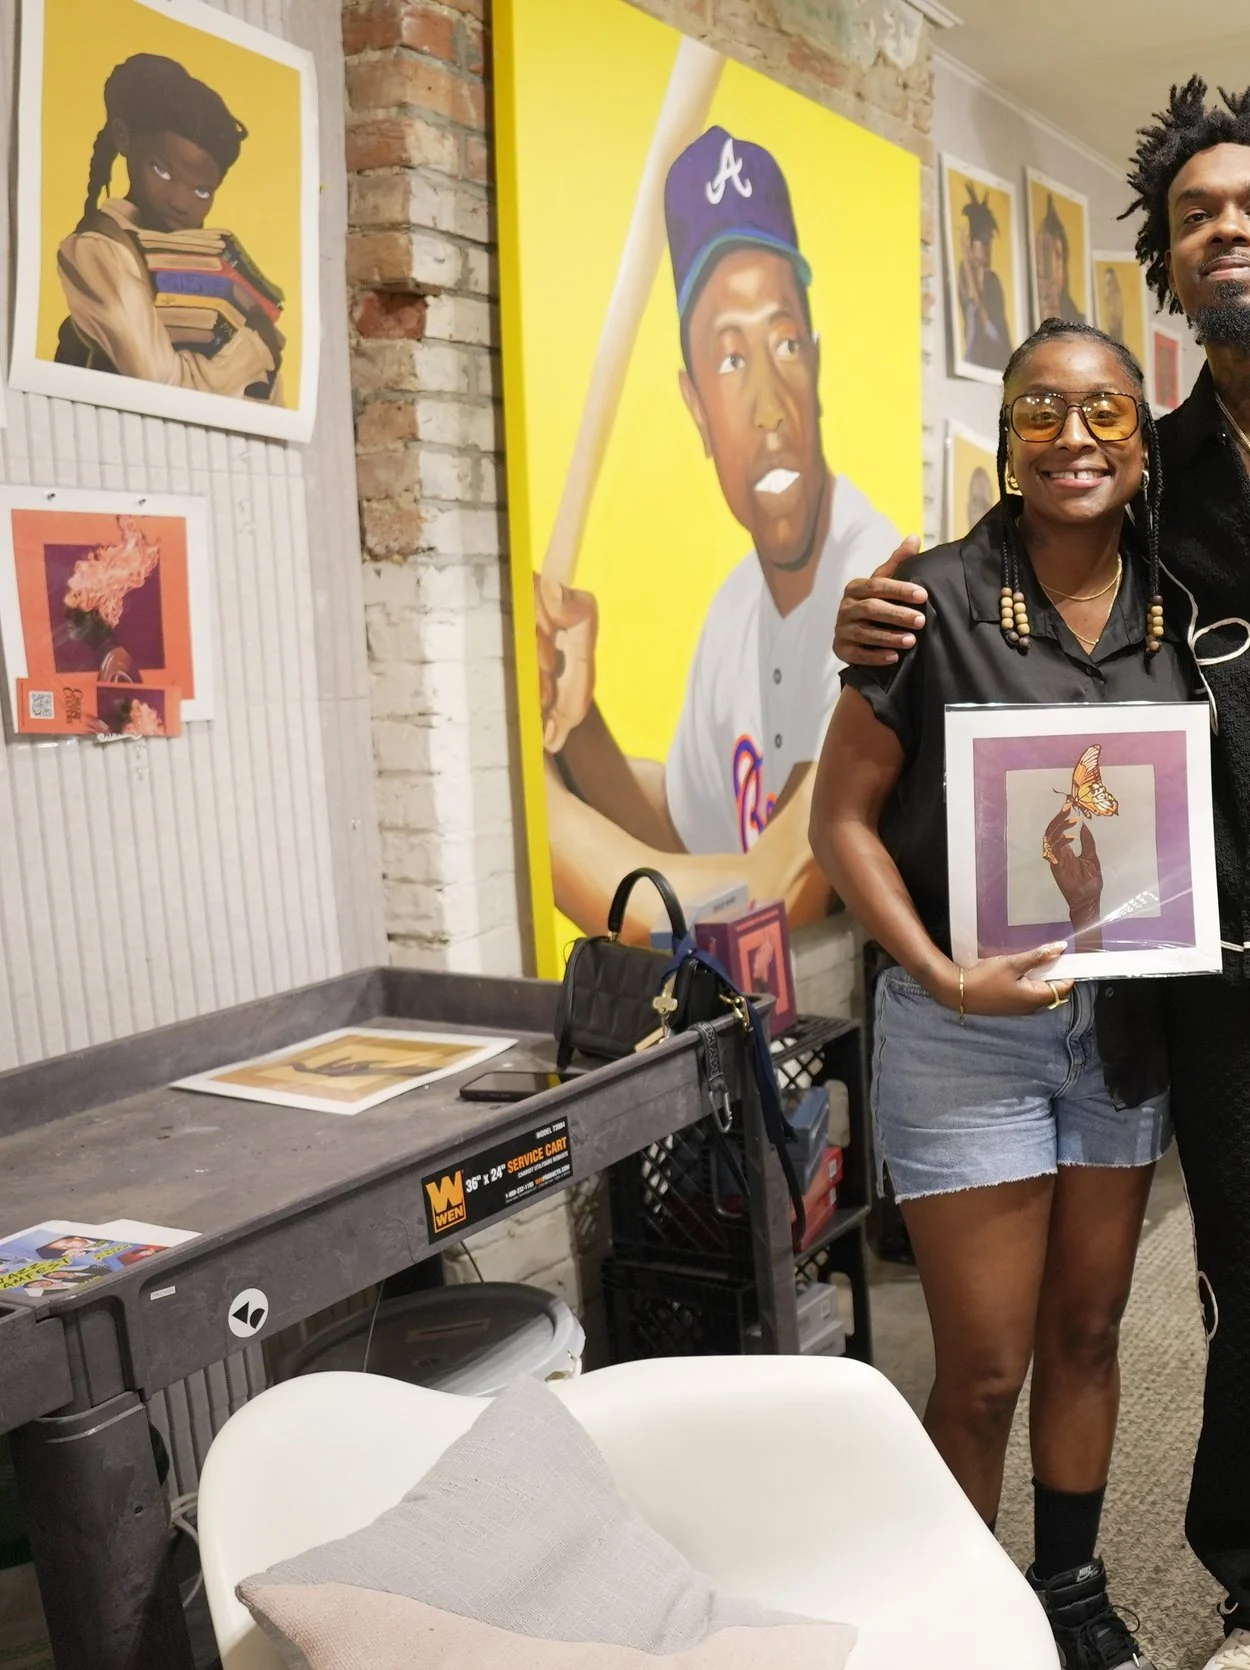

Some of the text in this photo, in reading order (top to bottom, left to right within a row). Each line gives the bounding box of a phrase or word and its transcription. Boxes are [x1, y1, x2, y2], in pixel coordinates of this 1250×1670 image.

[705, 138, 753, 205] A
[536, 1127, 552, 1139] MODEL
[465, 1136, 567, 1193] 36" x 24" SERVICE CART
[435, 1204, 465, 1227] WEN
